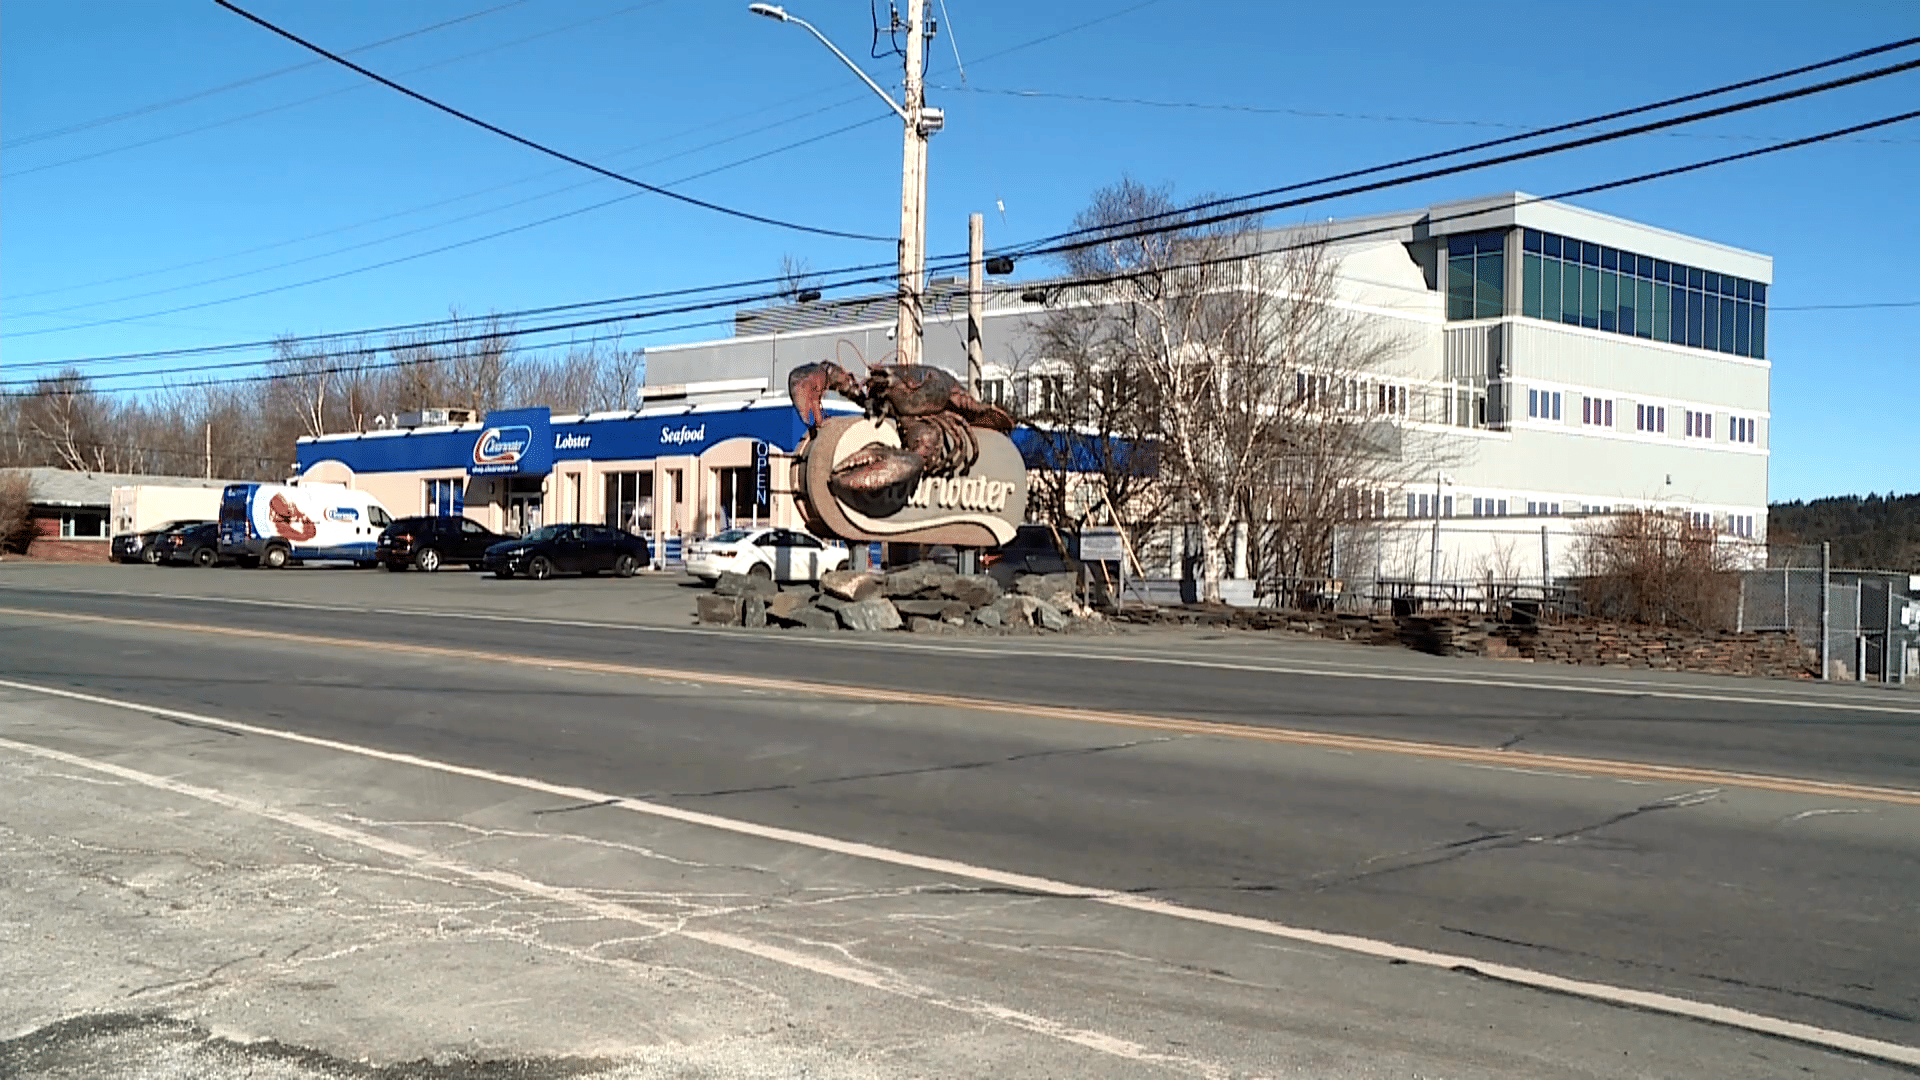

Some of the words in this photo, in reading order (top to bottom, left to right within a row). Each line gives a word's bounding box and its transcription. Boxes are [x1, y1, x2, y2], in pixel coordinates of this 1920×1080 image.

[555, 432, 591, 449] Lobster
[660, 423, 705, 446] Seafood
[757, 441, 768, 505] OPEN
